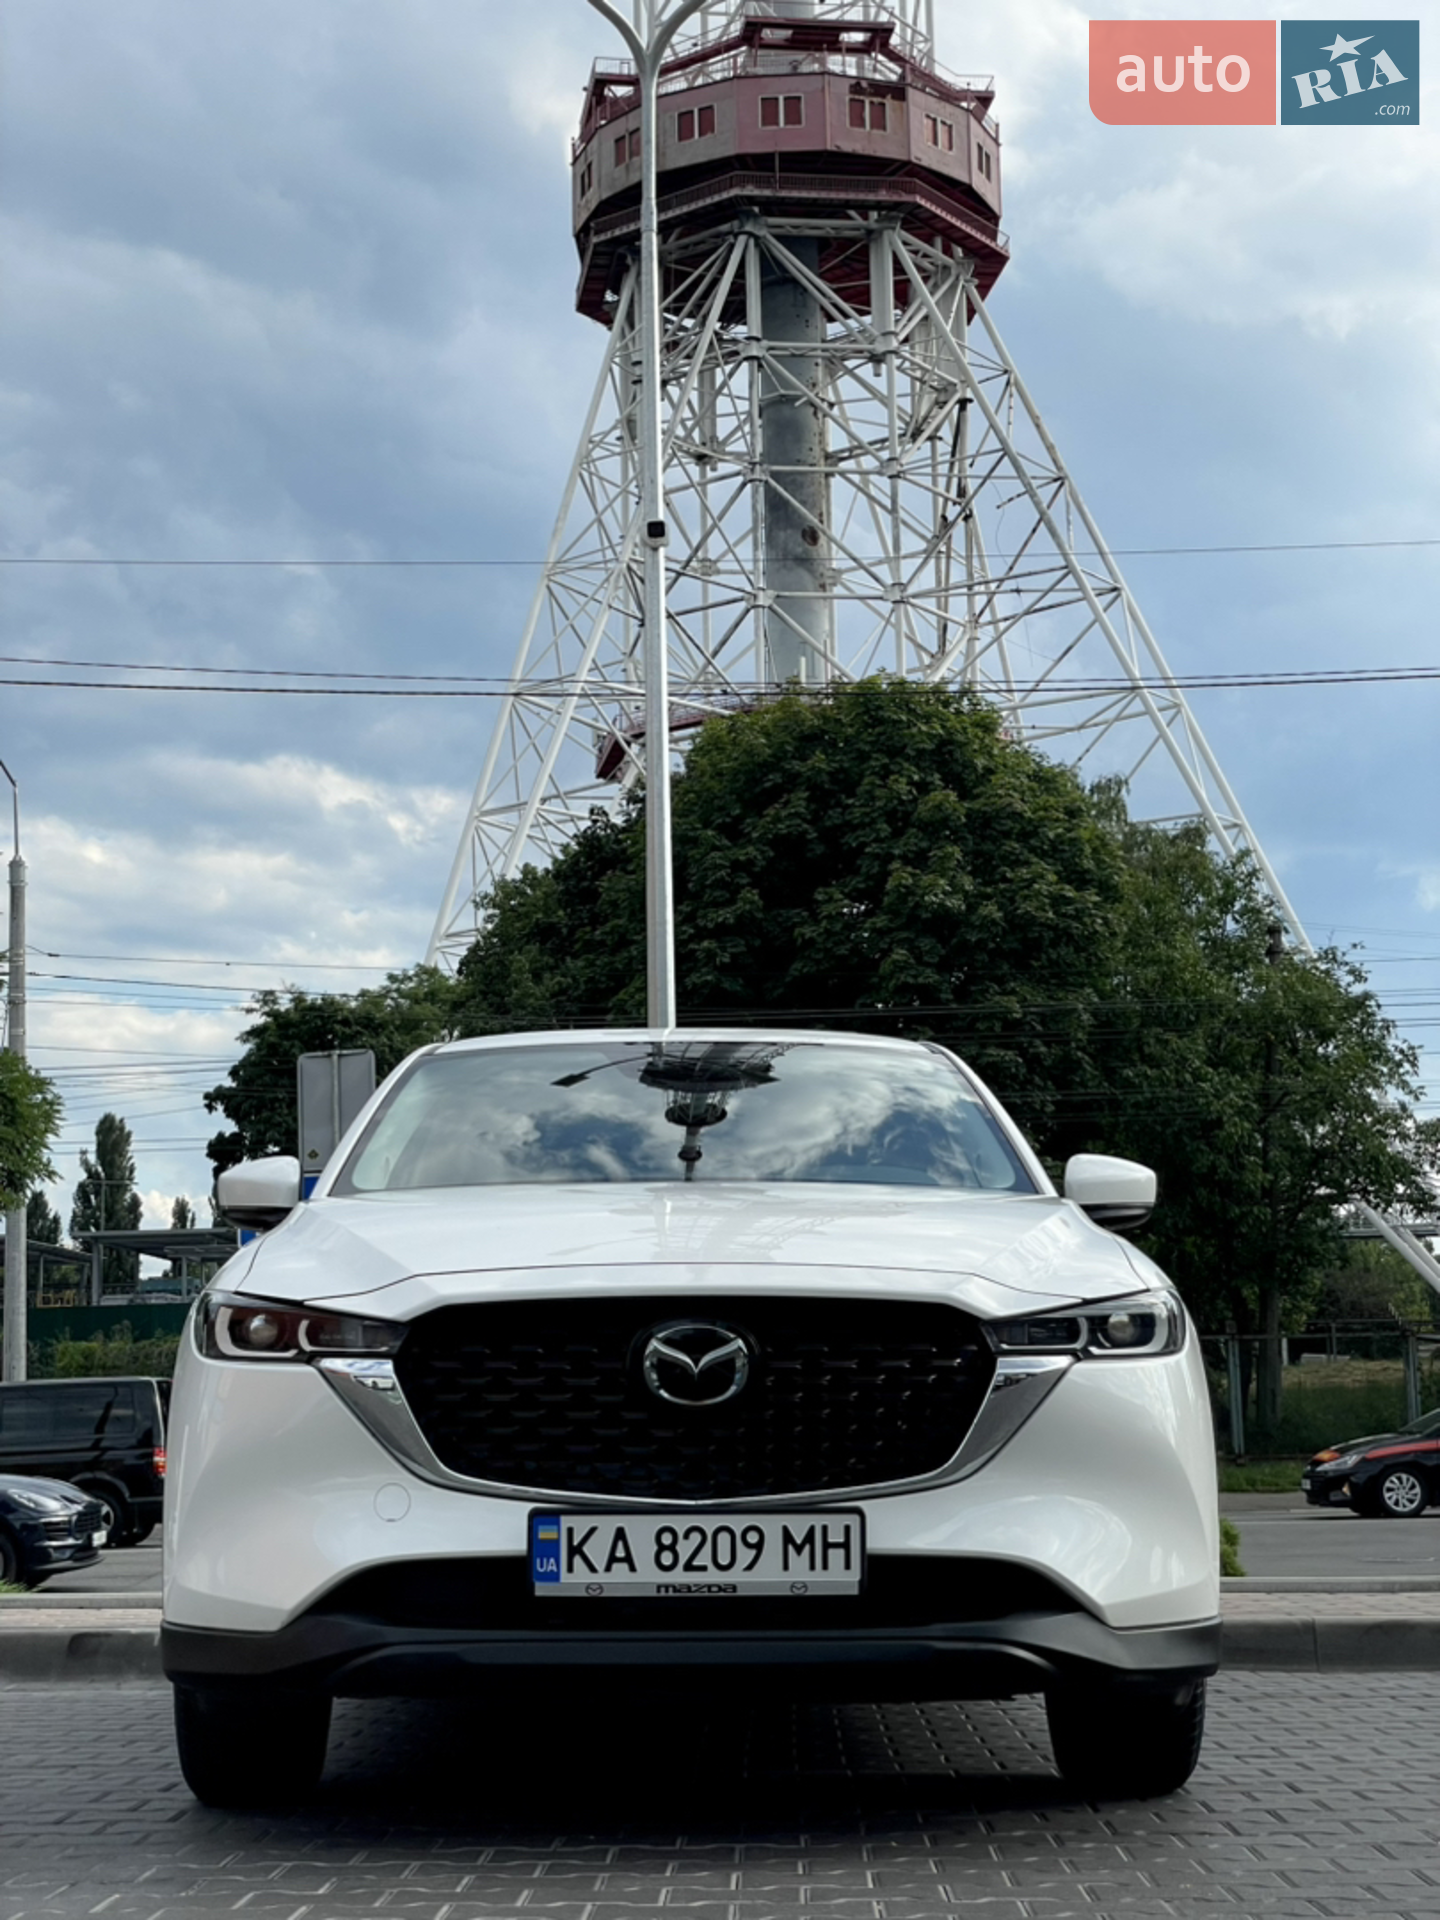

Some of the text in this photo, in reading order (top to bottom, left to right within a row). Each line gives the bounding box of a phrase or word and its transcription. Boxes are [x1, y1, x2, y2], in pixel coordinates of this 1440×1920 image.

[565, 1523, 851, 1573] KA 8209 MH
[536, 1557, 558, 1573] UA
